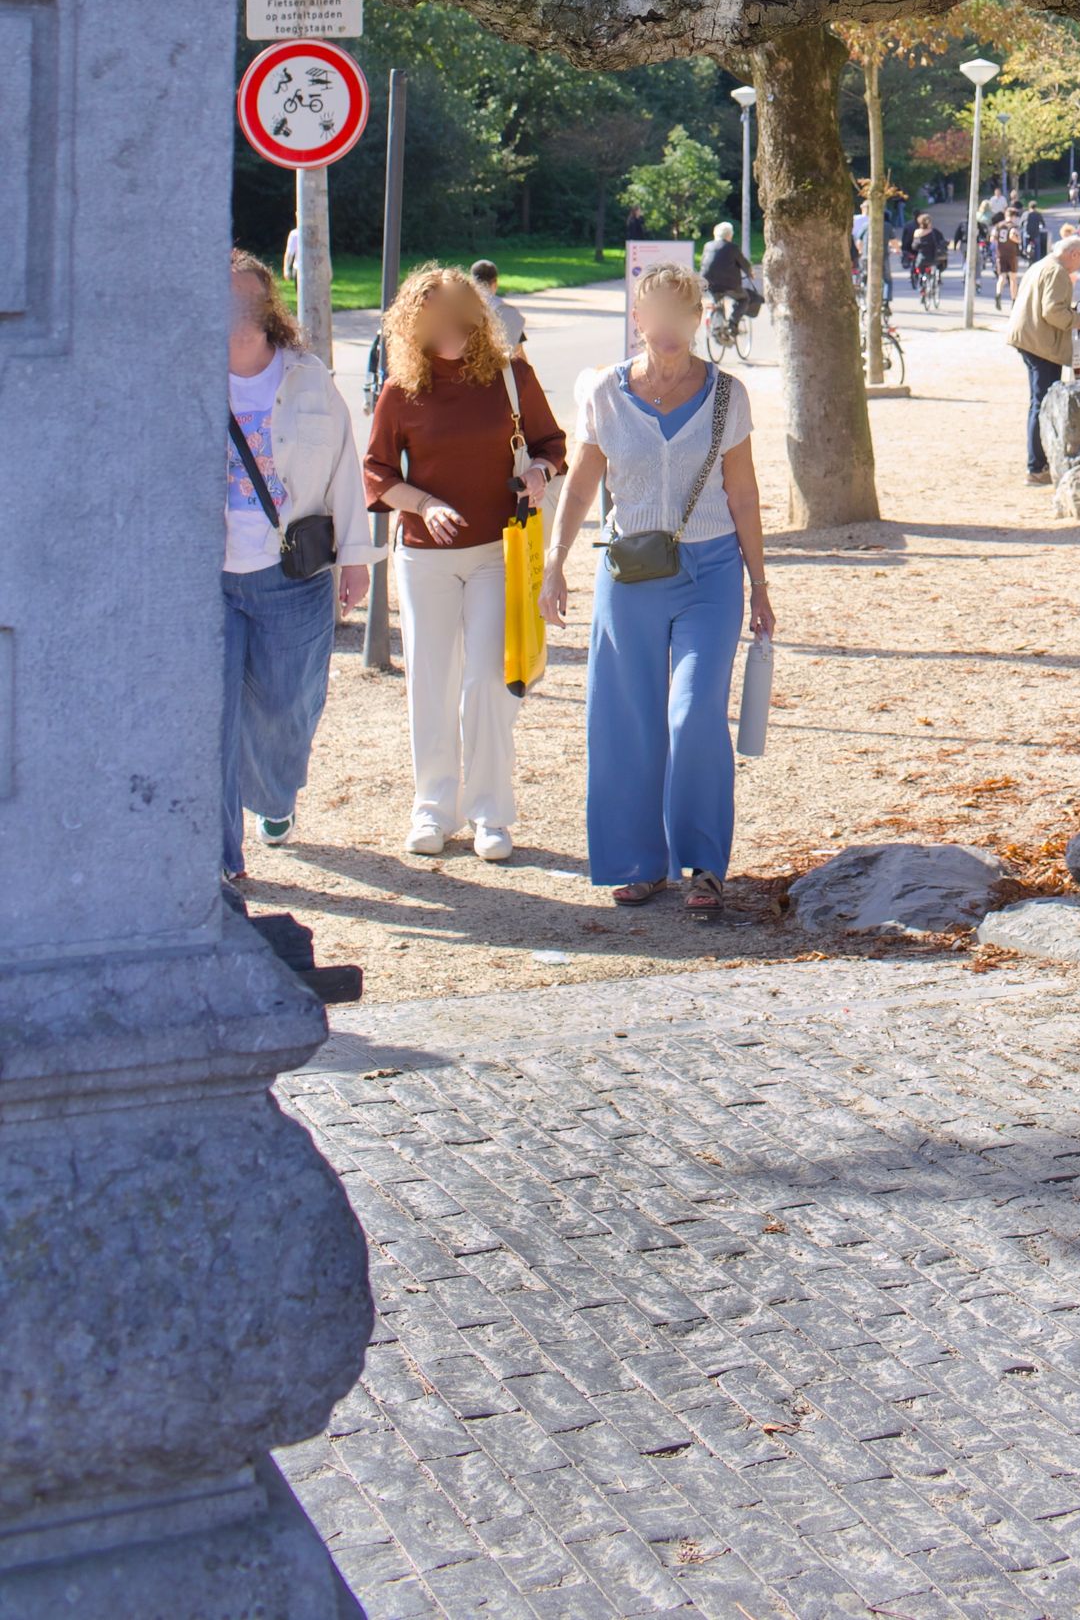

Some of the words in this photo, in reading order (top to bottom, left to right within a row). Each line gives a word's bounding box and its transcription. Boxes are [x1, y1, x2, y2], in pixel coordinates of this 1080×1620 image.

[265, 13, 278, 22] op
[281, 10, 343, 22] asfaltpaden
[275, 24, 334, 36] toegestaan
